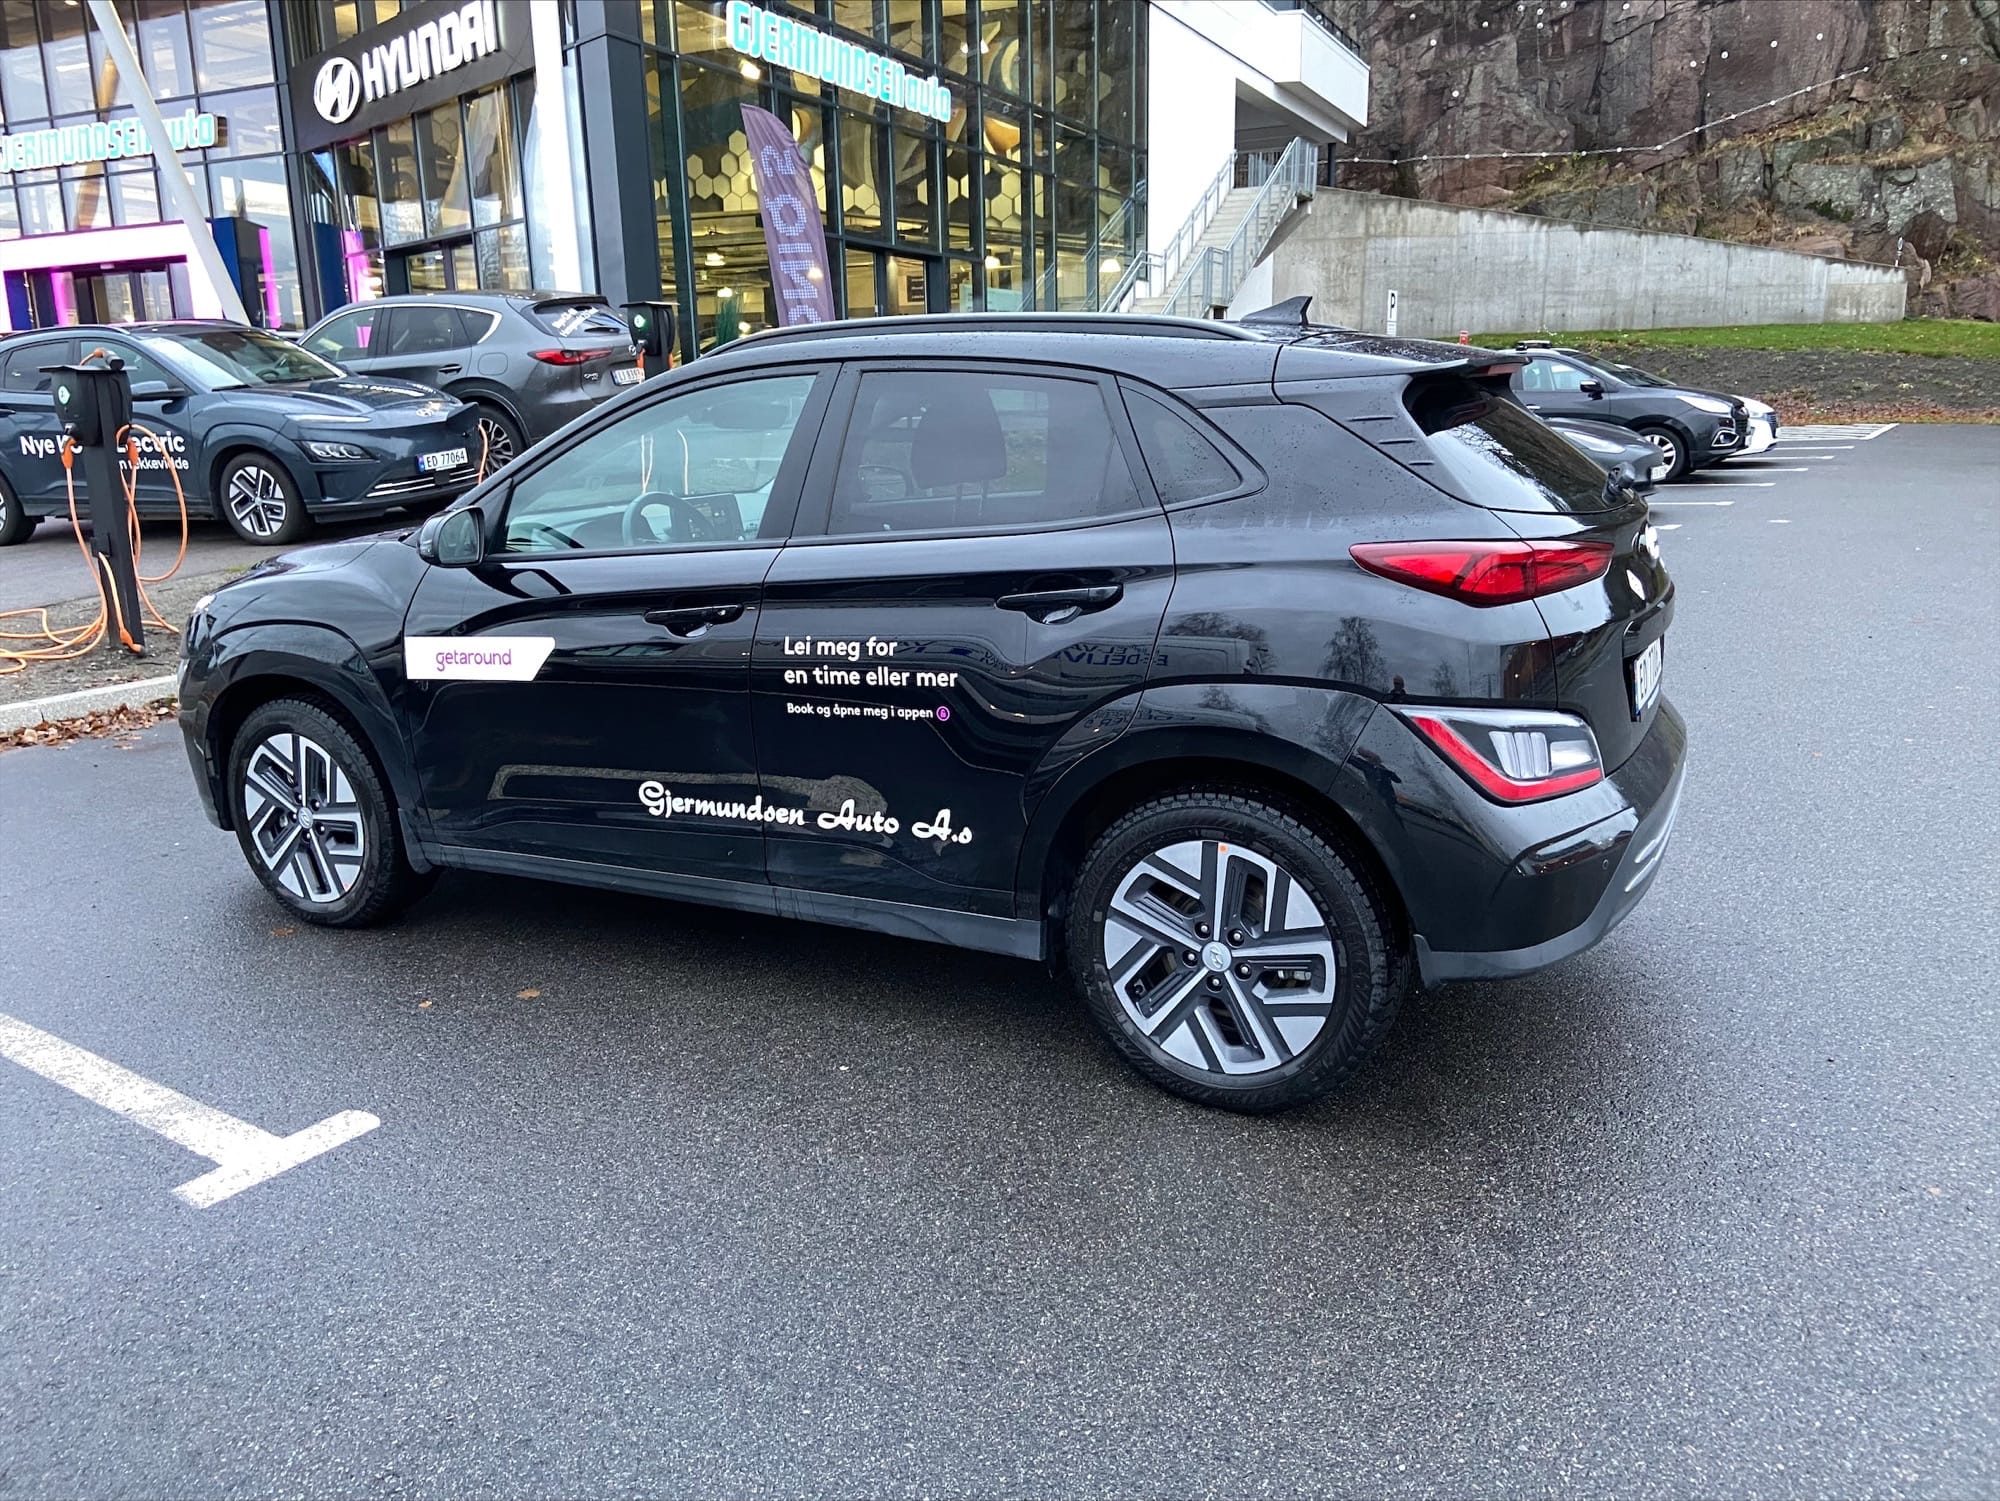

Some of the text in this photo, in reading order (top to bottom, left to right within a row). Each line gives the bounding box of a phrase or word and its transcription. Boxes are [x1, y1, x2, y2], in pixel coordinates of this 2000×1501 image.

[361, 0, 497, 103] HYUNDAI
[726, 0, 951, 122] GJERMUNDSEN auto
[0, 108, 215, 173] JERMUNDSEN uto
[1390, 292, 1396, 319] P
[20, 435, 55, 459] Nye
[435, 648, 512, 672] getaround
[784, 635, 898, 661] Lei meg for
[784, 665, 958, 687] en time eller mer
[787, 702, 933, 721] Book og åpne meg i appen
[638, 780, 806, 827] Gjermundsen
[817, 799, 900, 834] Auto
